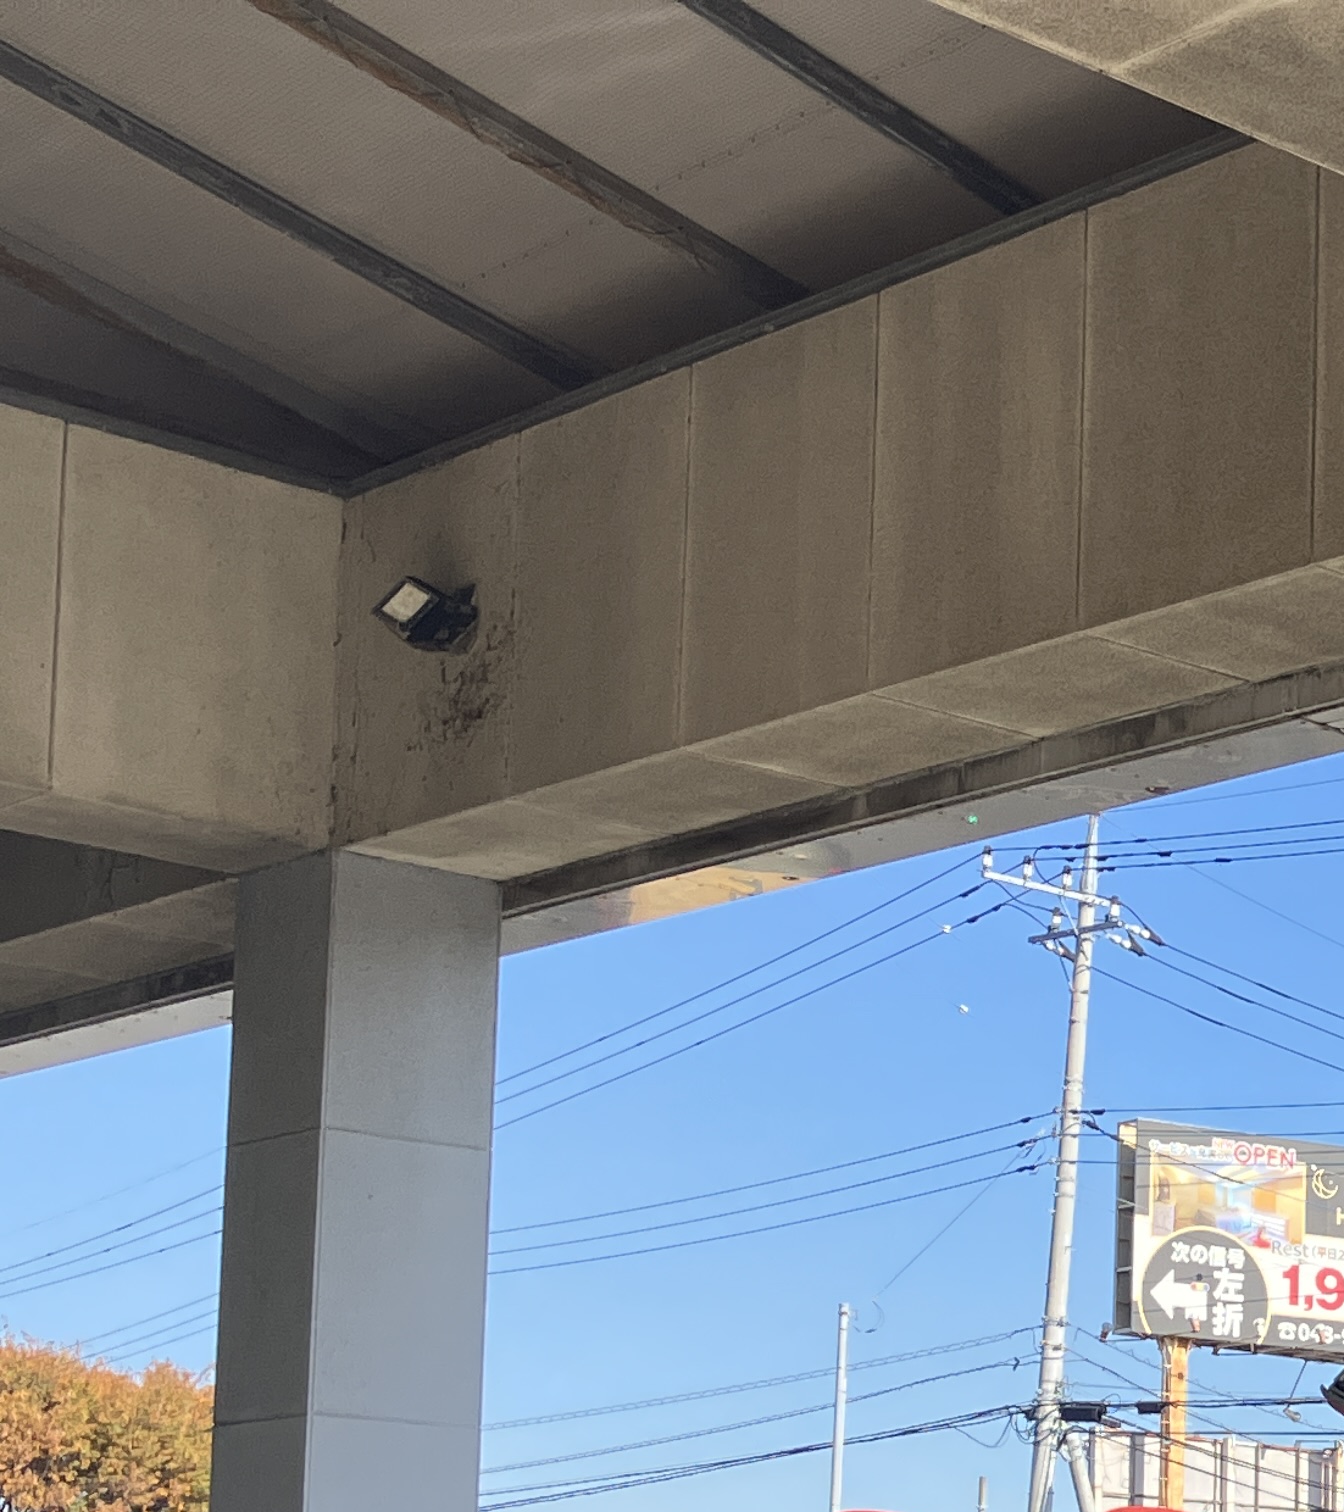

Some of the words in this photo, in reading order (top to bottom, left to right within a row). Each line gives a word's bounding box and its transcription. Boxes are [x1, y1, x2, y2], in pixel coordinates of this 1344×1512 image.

[1233, 1143, 1295, 1170] OPEN
[1170, 1241, 1246, 1270] 次の信号
[1271, 1240, 1309, 1258] Rest
[1212, 1267, 1245, 1338] 左折
